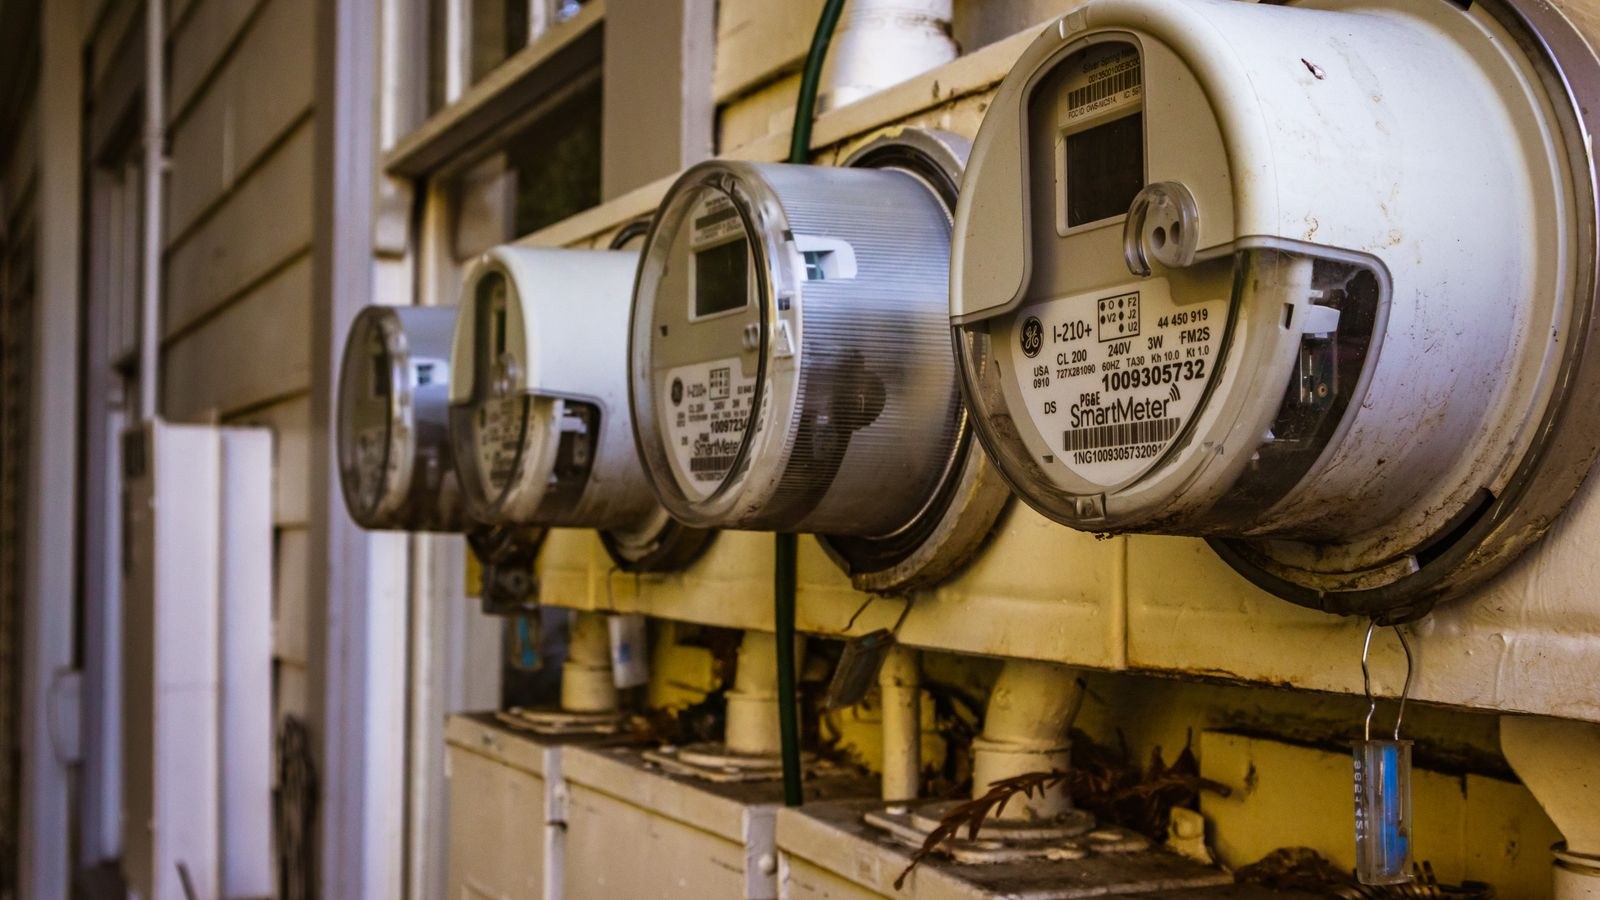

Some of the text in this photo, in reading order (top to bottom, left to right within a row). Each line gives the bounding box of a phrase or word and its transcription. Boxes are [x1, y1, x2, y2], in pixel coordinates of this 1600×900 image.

[1128, 297, 1137, 308] F2
[1107, 312, 1117, 323] V2
[1157, 308, 1208, 329] 44 450 919
[1128, 321, 1138, 332] U2
[1056, 327, 1211, 366] CL 200 240V 3W FM2S
[1126, 356, 1145, 368] TA30
[1151, 354, 1161, 364] Kh
[1164, 350, 1180, 361] 10.0
[1186, 347, 1195, 358] Kt
[1198, 345, 1209, 356] 1.0
[1033, 365, 1049, 377] USA
[1102, 358, 1205, 392] 1009305732
[1033, 377, 1049, 389] 0910
[1080, 391, 1100, 407] PG&E
[1044, 401, 1057, 414] DS
[1070, 396, 1170, 428] SmartMeter
